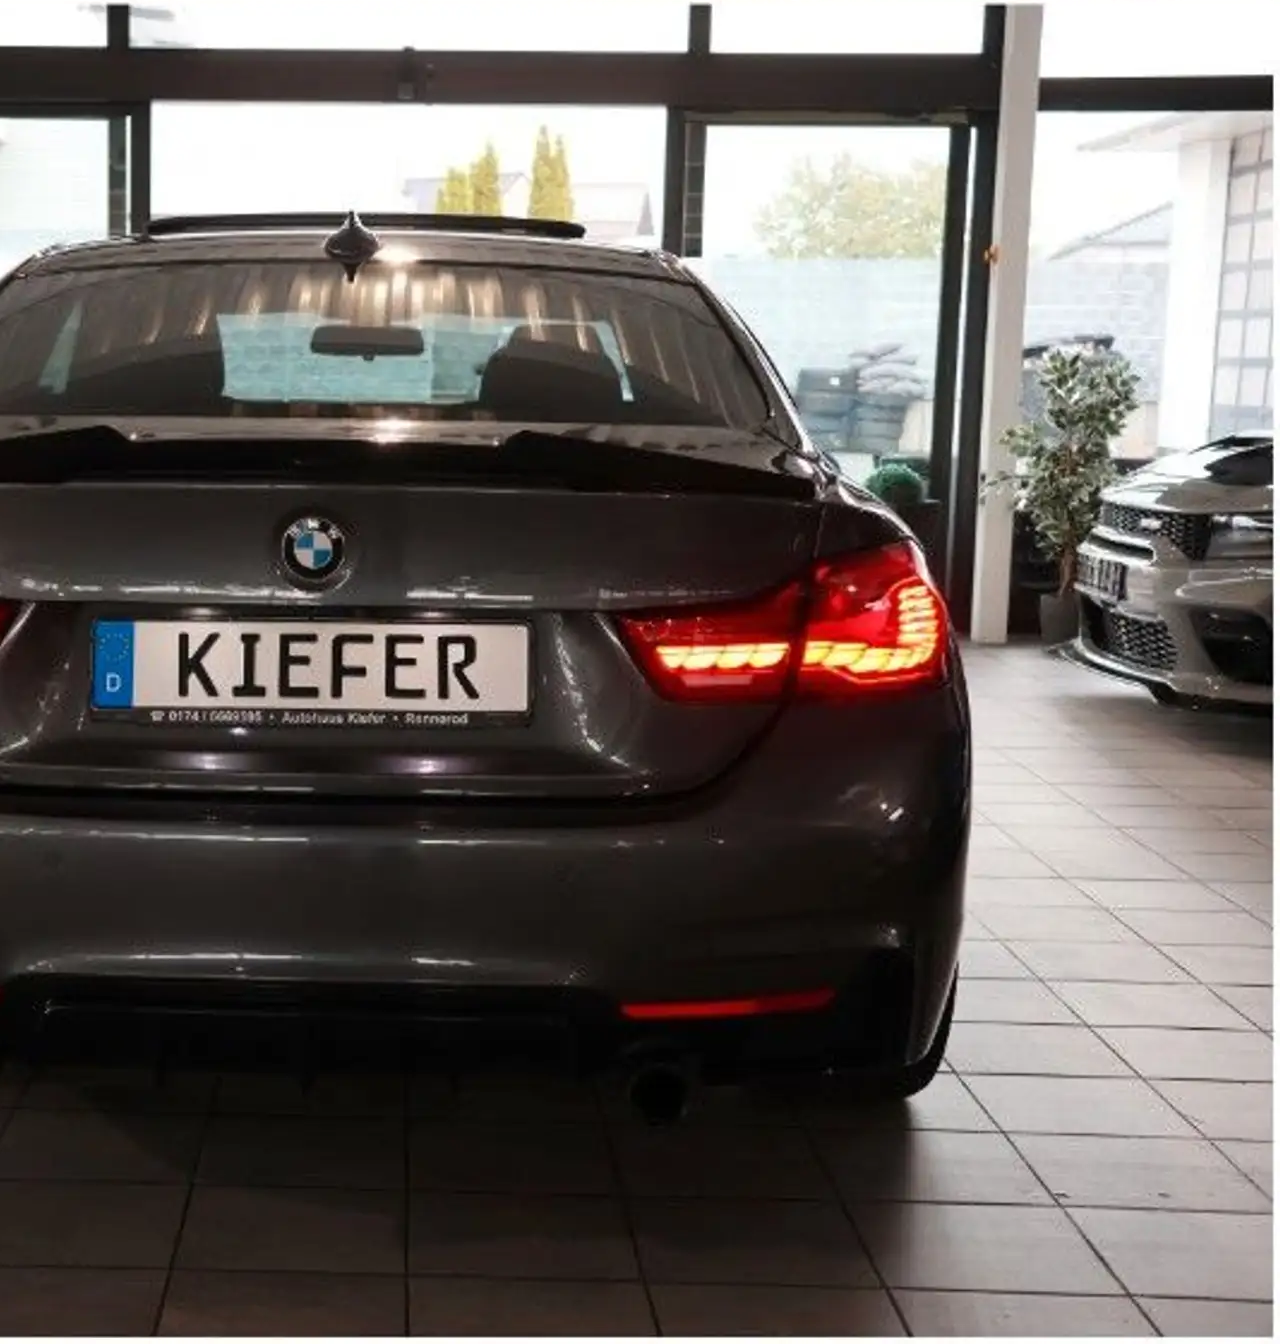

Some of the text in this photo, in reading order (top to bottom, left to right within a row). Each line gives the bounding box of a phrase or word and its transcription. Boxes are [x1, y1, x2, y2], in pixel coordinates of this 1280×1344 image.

[178, 631, 480, 700] KIEFER
[105, 672, 123, 693] D
[168, 710, 200, 723] 0174
[281, 713, 344, 726] Autohaus
[346, 713, 387, 725] Kiefer
